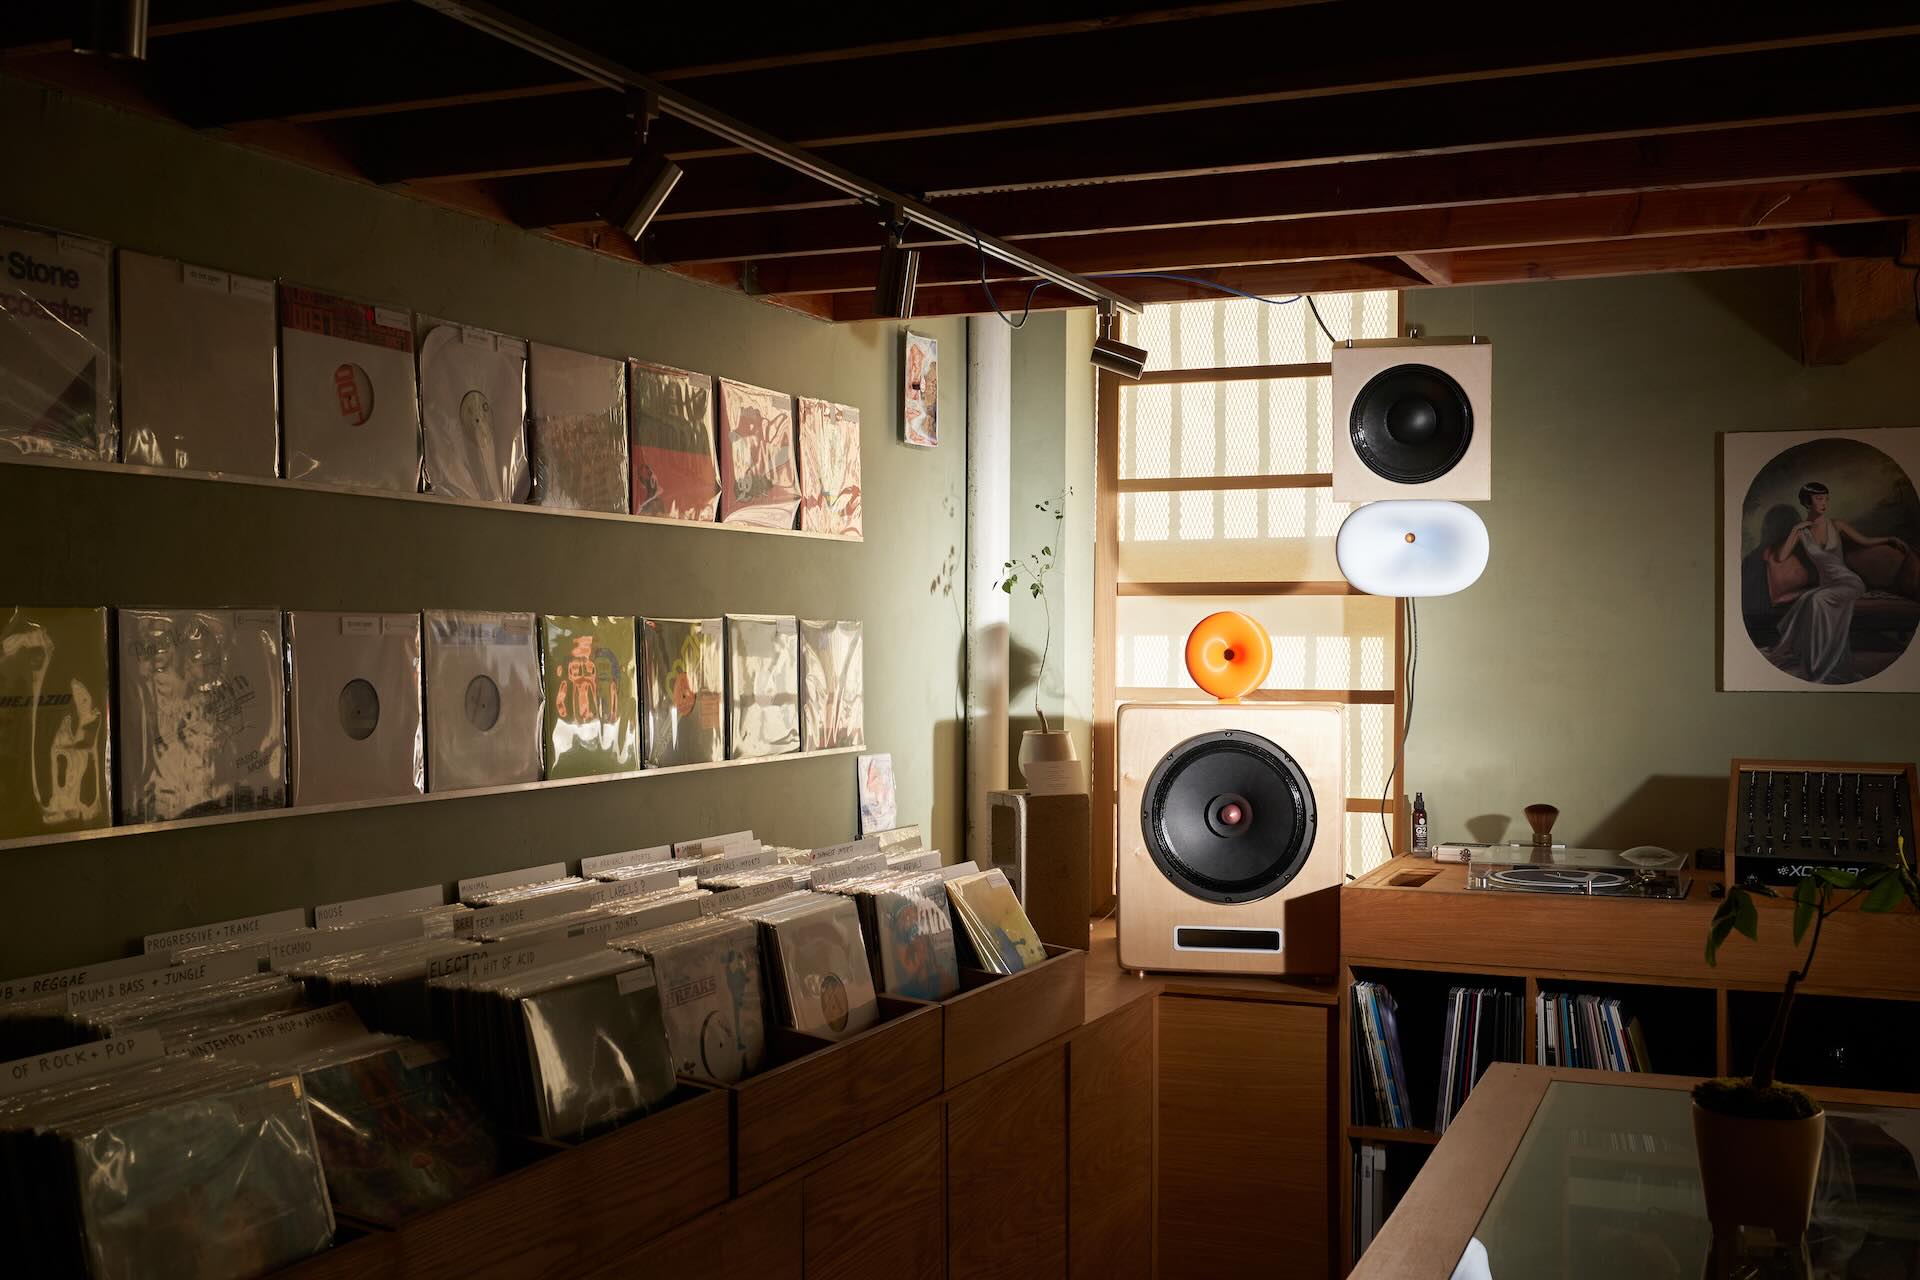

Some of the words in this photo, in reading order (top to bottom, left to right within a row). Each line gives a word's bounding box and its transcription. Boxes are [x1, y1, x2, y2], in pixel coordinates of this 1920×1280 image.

[7, 251, 80, 288] Stone
[0, 293, 93, 326] coaster
[318, 906, 343, 921] HOUSE
[475, 917, 495, 929] TECH
[500, 910, 524, 923] HOUSE
[147, 928, 213, 951] PROGRESSIVE
[224, 920, 259, 937] TRANCE
[272, 941, 312, 959] TECHNO
[484, 960, 498, 975] HIT
[502, 956, 512, 970] OF
[517, 952, 535, 966] ACID
[33, 972, 87, 993] REGGAE
[71, 987, 105, 1007] DRUM
[119, 978, 145, 997] BASS
[164, 965, 206, 986] JUNGLE
[253, 1026, 275, 1041] TRIP
[280, 1020, 297, 1035] HOP
[12, 1063, 30, 1079] OF
[40, 1051, 87, 1073] ROCK
[105, 1040, 135, 1060] POP
